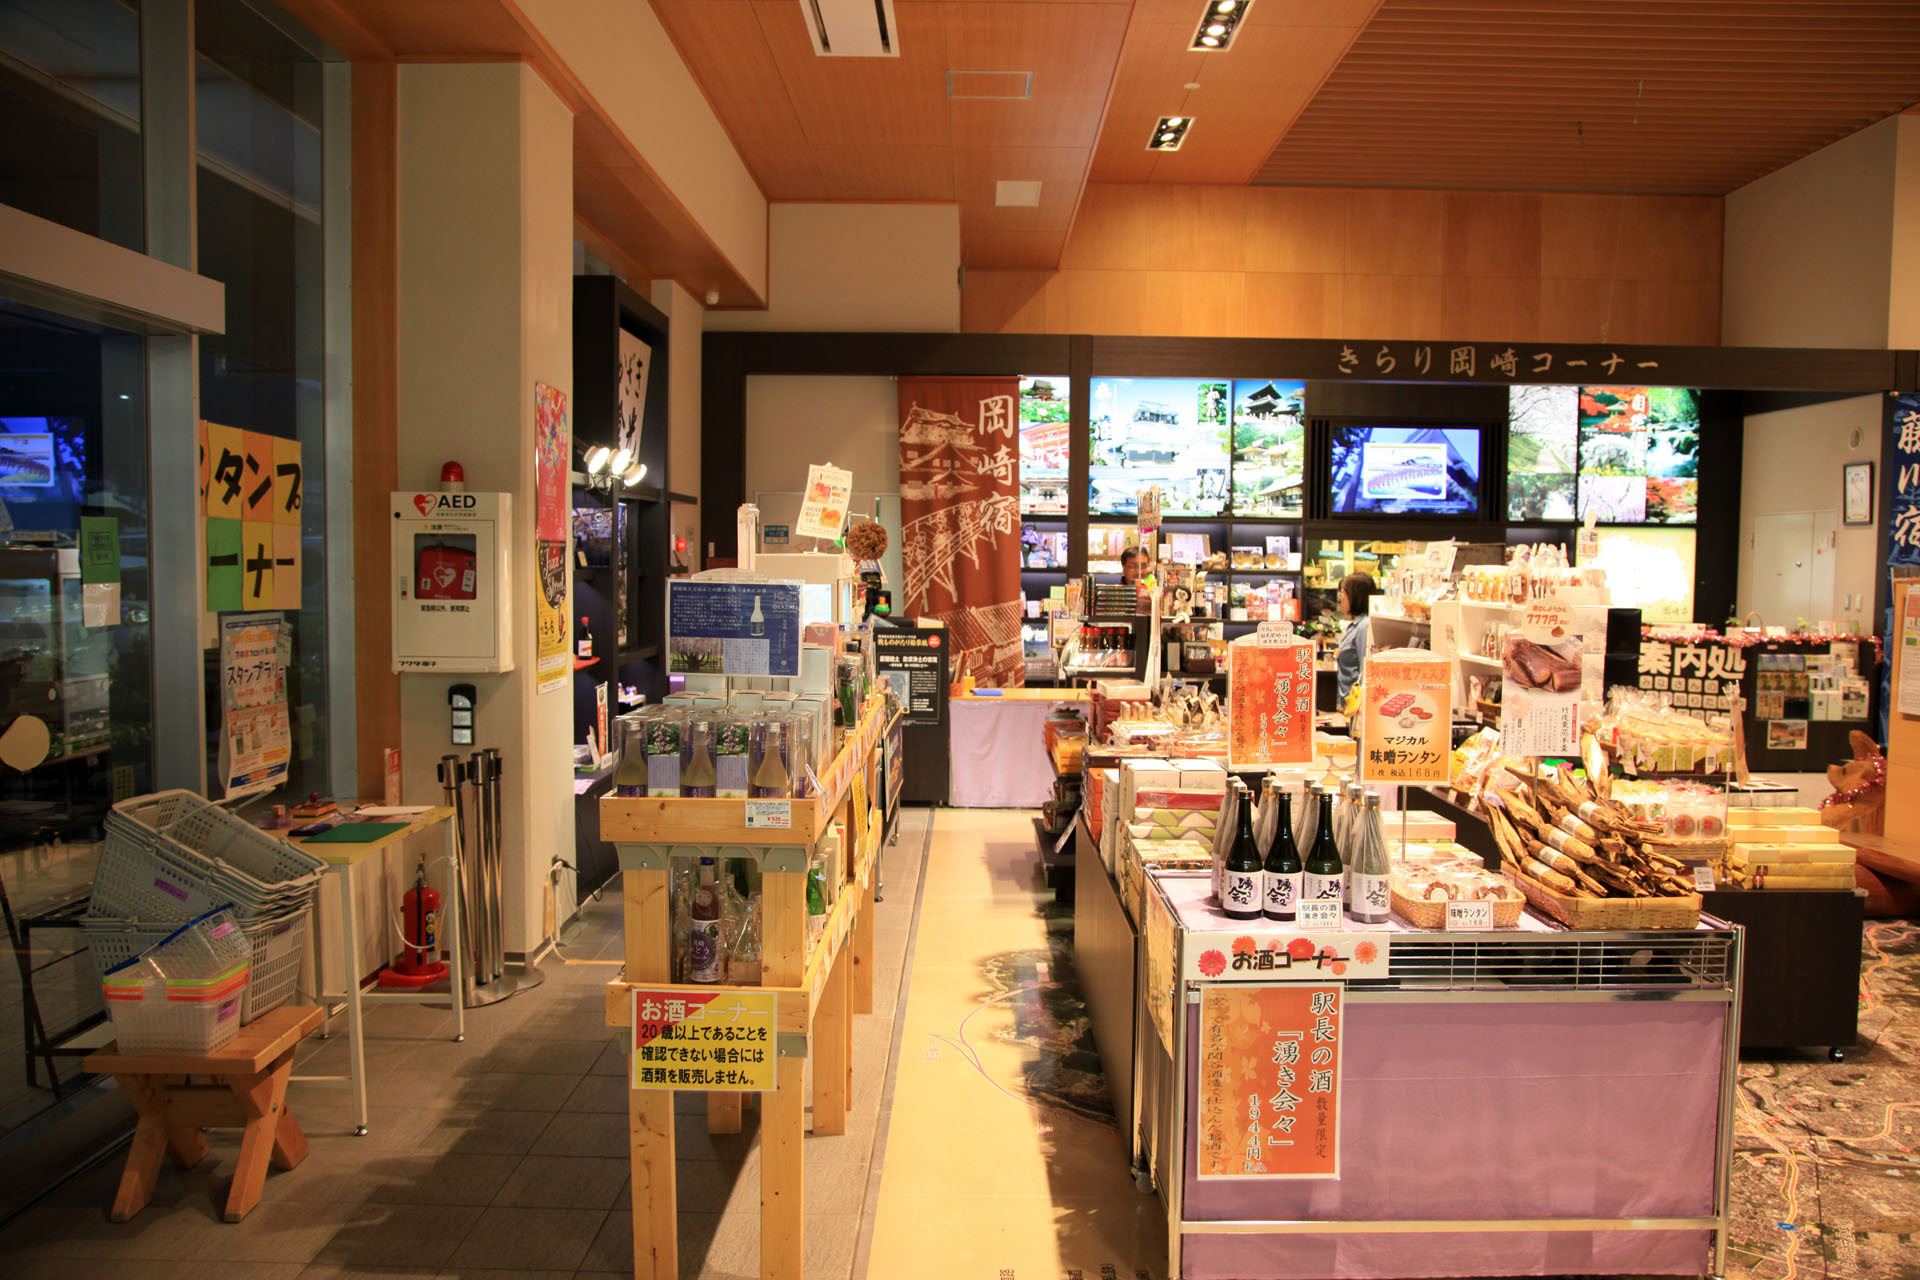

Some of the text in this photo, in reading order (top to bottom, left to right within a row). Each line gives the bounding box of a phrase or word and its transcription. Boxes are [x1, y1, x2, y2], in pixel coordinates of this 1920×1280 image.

[1337, 345, 1659, 377] きらり岡崎コーナー
[976, 394, 1017, 535] 岡崎宿
[200, 446, 301, 512] タンプ
[437, 494, 476, 509] AED
[1527, 614, 1559, 625] 777円
[1638, 641, 1747, 680] 案内処
[226, 661, 285, 686] スタンプラリー
[1295, 647, 1312, 712] 駅長の酒
[1383, 735, 1429, 746] マジカル
[1370, 749, 1442, 765] 味噌ランタン
[1302, 903, 1338, 912] 駅長の酒
[1450, 908, 1488, 919] 味噌ランタン
[1231, 949, 1350, 971] お酒コーナー
[641, 998, 769, 1023] お酒コーナー
[641, 1046, 764, 1063] 確認できない場合には
[1309, 992, 1337, 1094] 駅長の酒
[641, 1067, 755, 1085] 酒類を販売しません。
[1268, 1030, 1304, 1146] 「湧き会々」
[1246, 1094, 1262, 1160] 1944円
[1314, 1097, 1328, 1159] 数量限定
